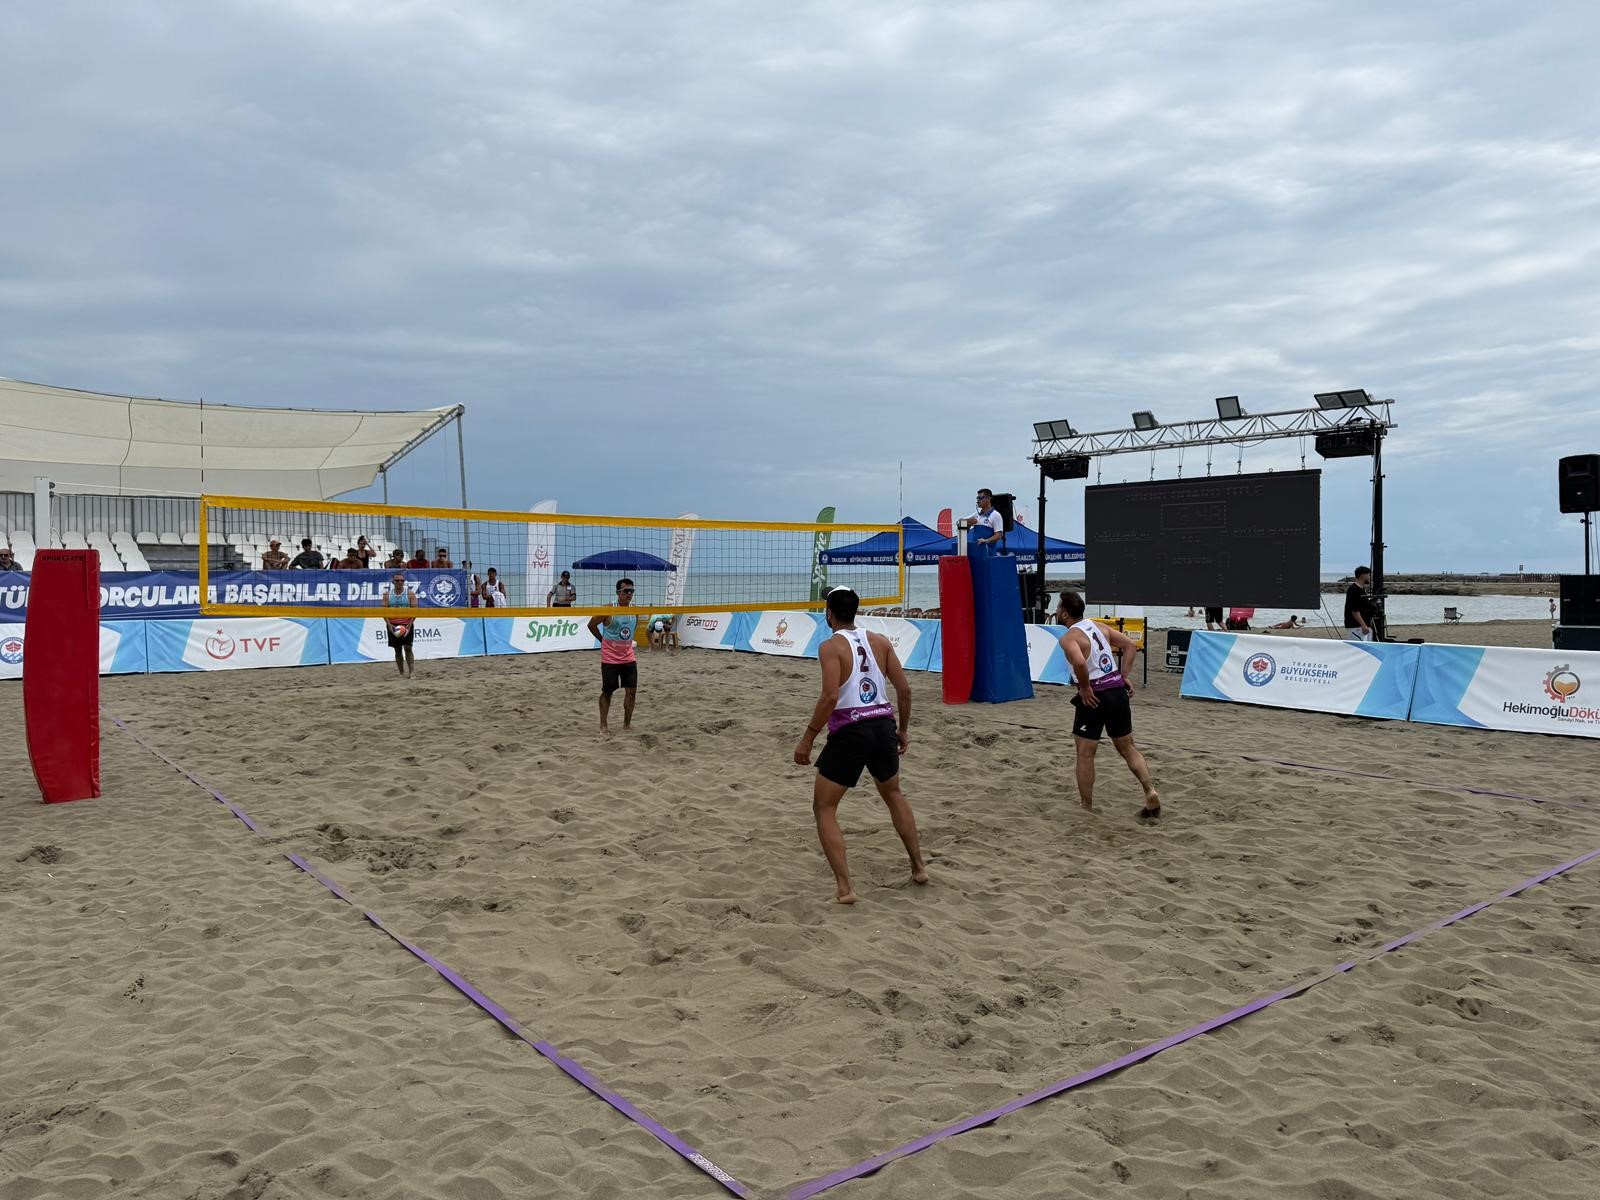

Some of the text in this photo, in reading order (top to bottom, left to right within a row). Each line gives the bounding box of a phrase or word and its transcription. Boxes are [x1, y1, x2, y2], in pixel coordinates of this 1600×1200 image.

[532, 561, 550, 569] TVF
[224, 583, 342, 606] BAŞARILAR
[375, 628, 442, 640] BIRMA
[526, 619, 579, 642] Sprite
[239, 637, 281, 653] TVF
[1092, 631, 1104, 651] 1
[857, 646, 869, 672] 2
[1292, 661, 1329, 669] TRABZON
